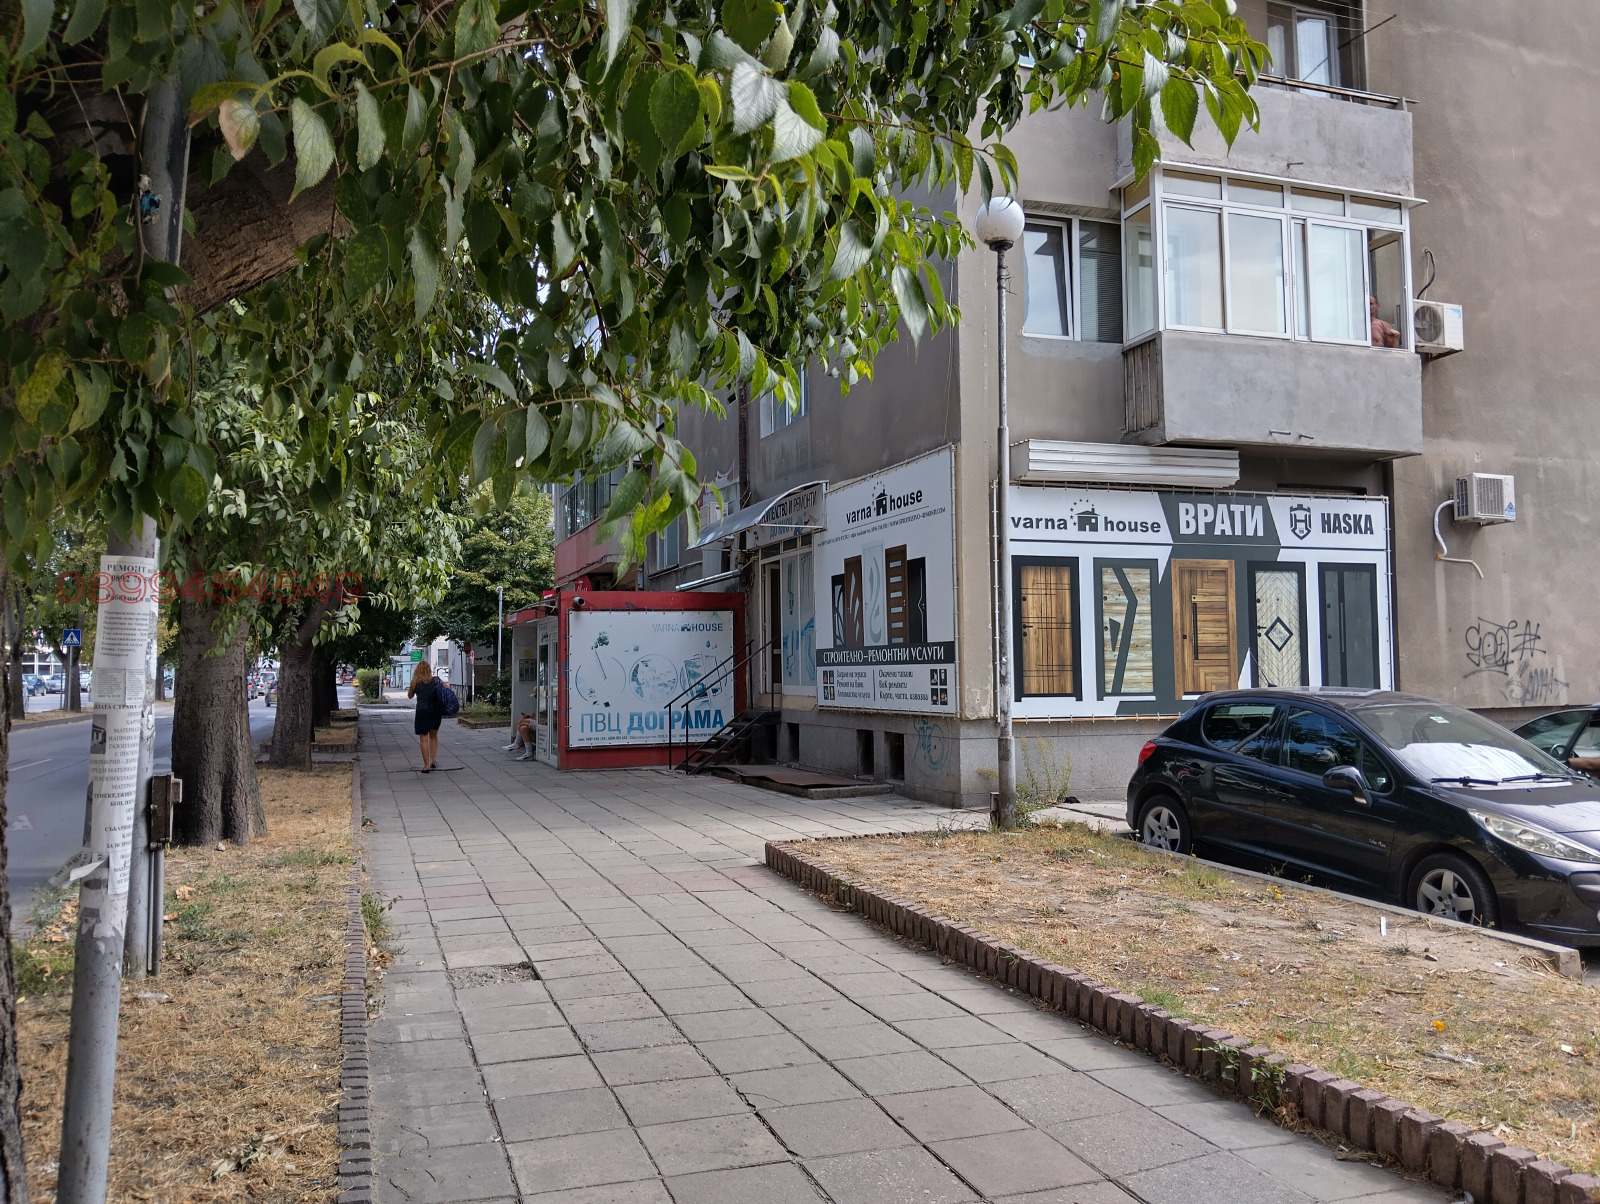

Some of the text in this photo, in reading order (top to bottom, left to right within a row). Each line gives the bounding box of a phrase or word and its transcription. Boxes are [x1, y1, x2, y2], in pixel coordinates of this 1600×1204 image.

[845, 488, 923, 525] varna house
[1010, 516, 1161, 533] varna house
[1178, 502, 1264, 537] ВРАТИ
[1320, 512, 1374, 535] HASKA
[652, 623, 724, 632] VARNA HOUSE
[911, 645, 945, 661] УСЛУГИ
[581, 710, 725, 735] ПВЦ ДОГРАМА
